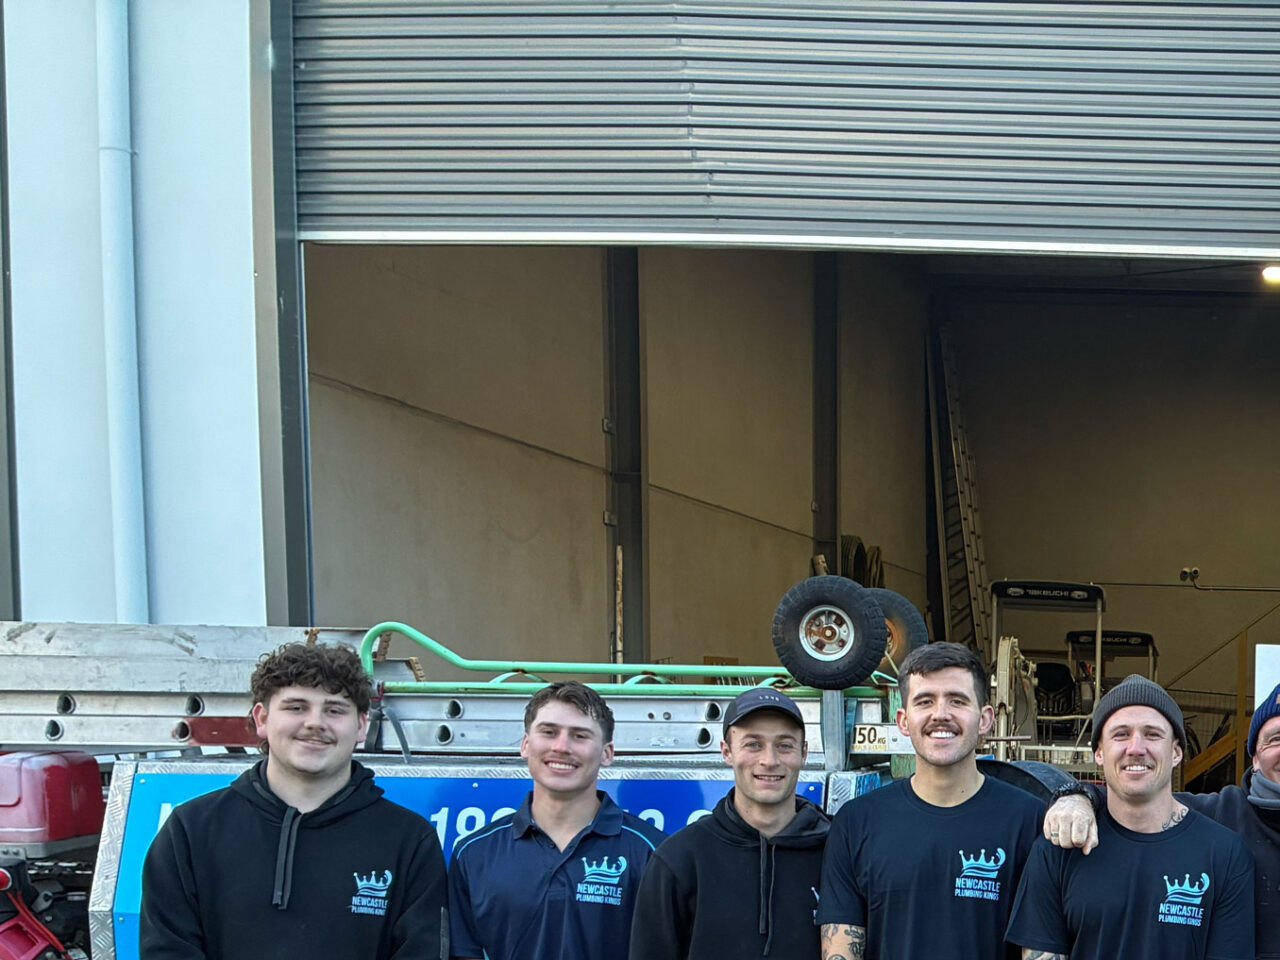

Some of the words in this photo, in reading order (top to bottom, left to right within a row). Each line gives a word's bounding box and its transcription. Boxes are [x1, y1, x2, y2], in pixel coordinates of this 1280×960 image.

[577, 882, 623, 898] NEWCASTLE
[956, 877, 1001, 892] NEWCASTLE
[955, 888, 982, 898] PLUMBING
[352, 895, 389, 909] NEWCASTLE
[1159, 902, 1204, 919] NEWCASTLE
[1158, 913, 1187, 925] PLUMBING
